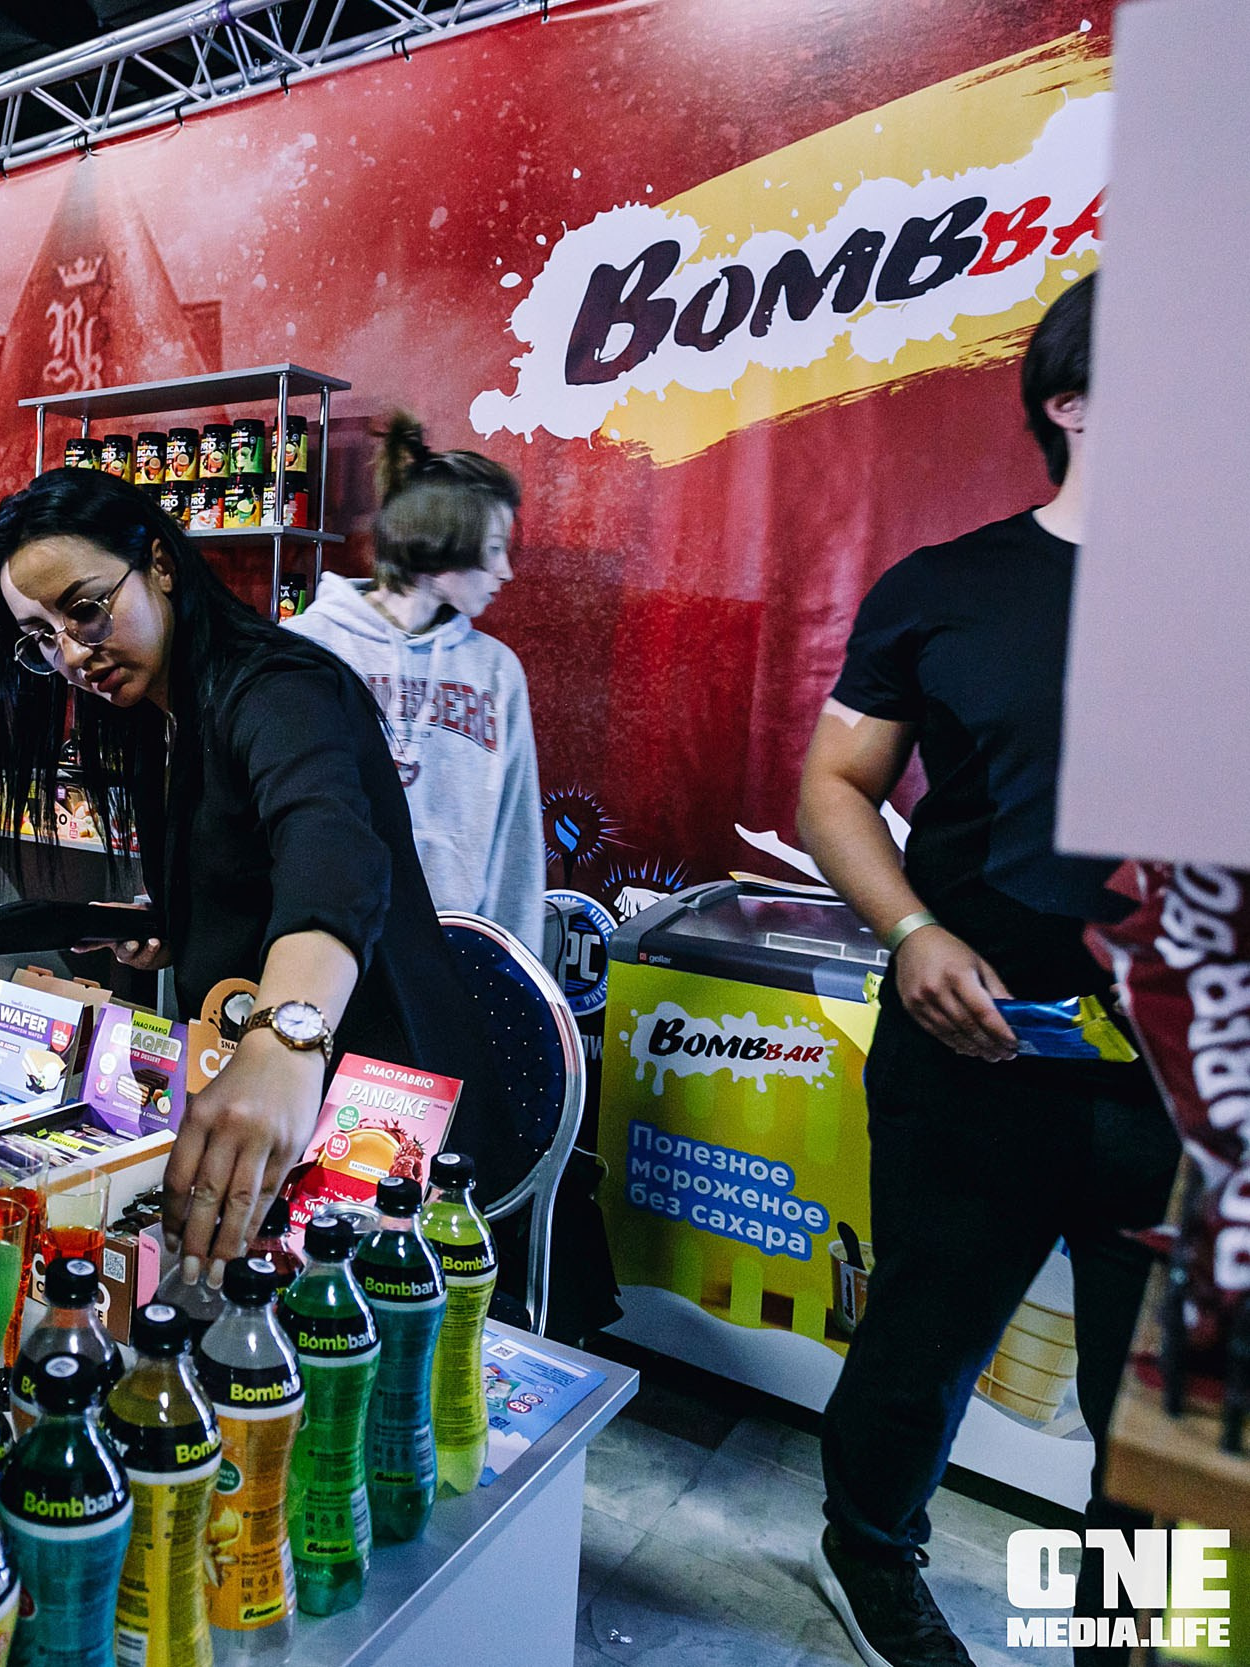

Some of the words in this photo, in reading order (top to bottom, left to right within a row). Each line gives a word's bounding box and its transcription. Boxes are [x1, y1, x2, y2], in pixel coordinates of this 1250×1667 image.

[161, 498, 178, 507] PRO
[0, 1005, 48, 1034] WAFER
[9, 1025, 28, 1036] PROTEIN
[28, 1030, 43, 1039] WAFER
[140, 1051, 161, 1064] DESSERT
[363, 1063, 394, 1079] SNAQ
[394, 1071, 435, 1089] FABRIQ
[346, 1082, 431, 1120] PANCAKE
[339, 1114, 357, 1123] SUGAR
[332, 1137, 347, 1151] 103
[632, 1124, 789, 1188] Полезное
[631, 1157, 824, 1228] мороженое
[630, 1182, 681, 1216] без
[691, 1202, 807, 1255] сахара
[364, 1276, 435, 1297] Bombbar
[23, 1490, 116, 1518] Bombbar
